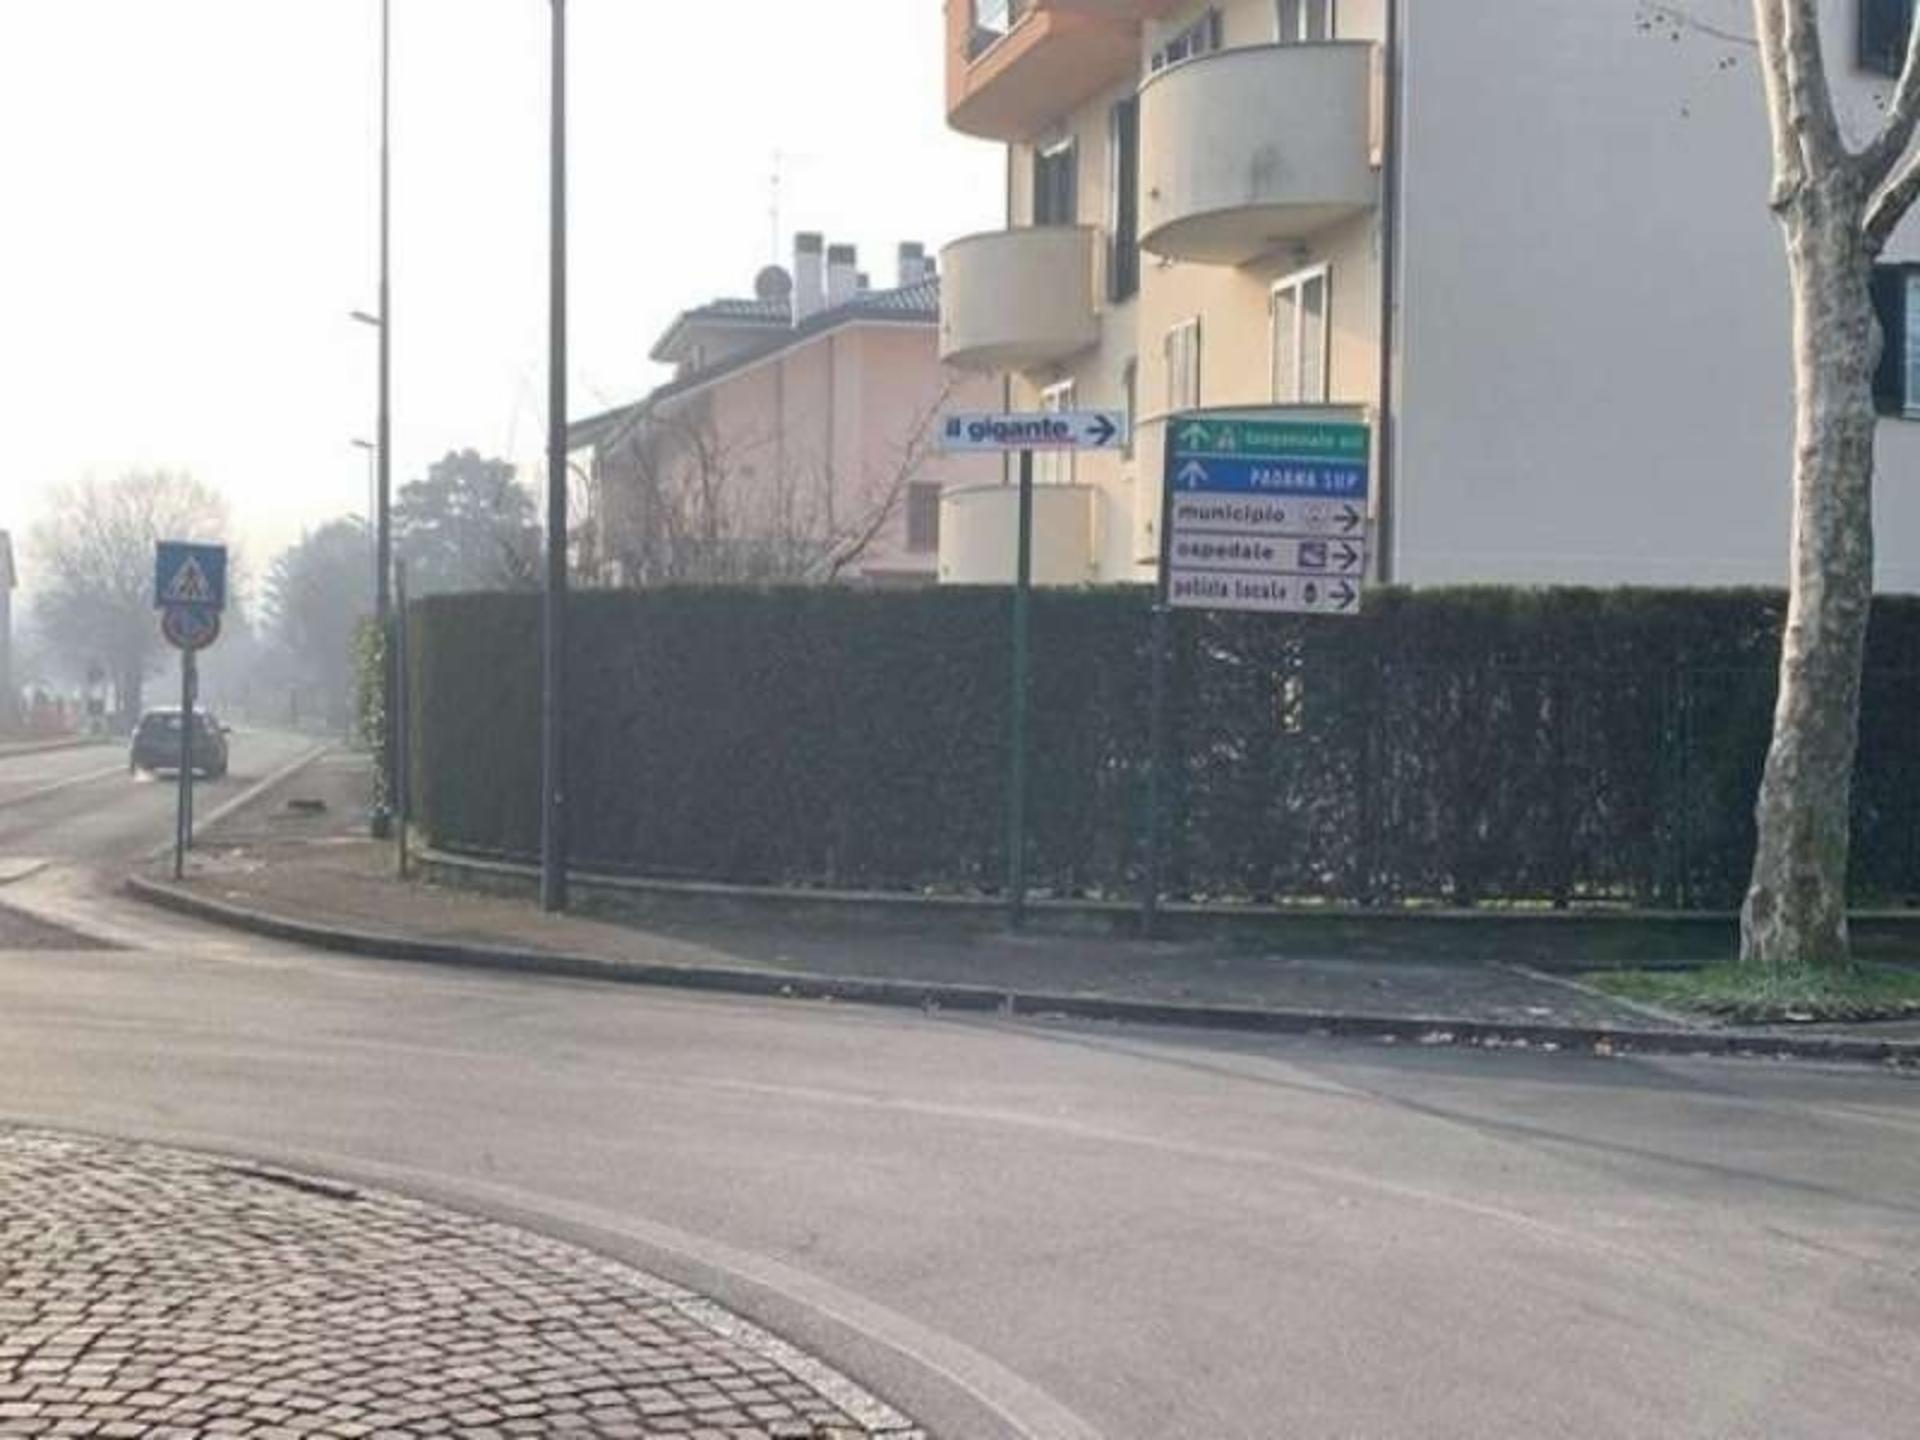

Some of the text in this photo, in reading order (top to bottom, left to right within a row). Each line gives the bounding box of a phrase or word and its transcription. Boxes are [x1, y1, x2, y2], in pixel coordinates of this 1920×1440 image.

[945, 417, 1069, 443] il gigante
[1177, 504, 1285, 525] municipio
[1176, 539, 1274, 561] ospedale
